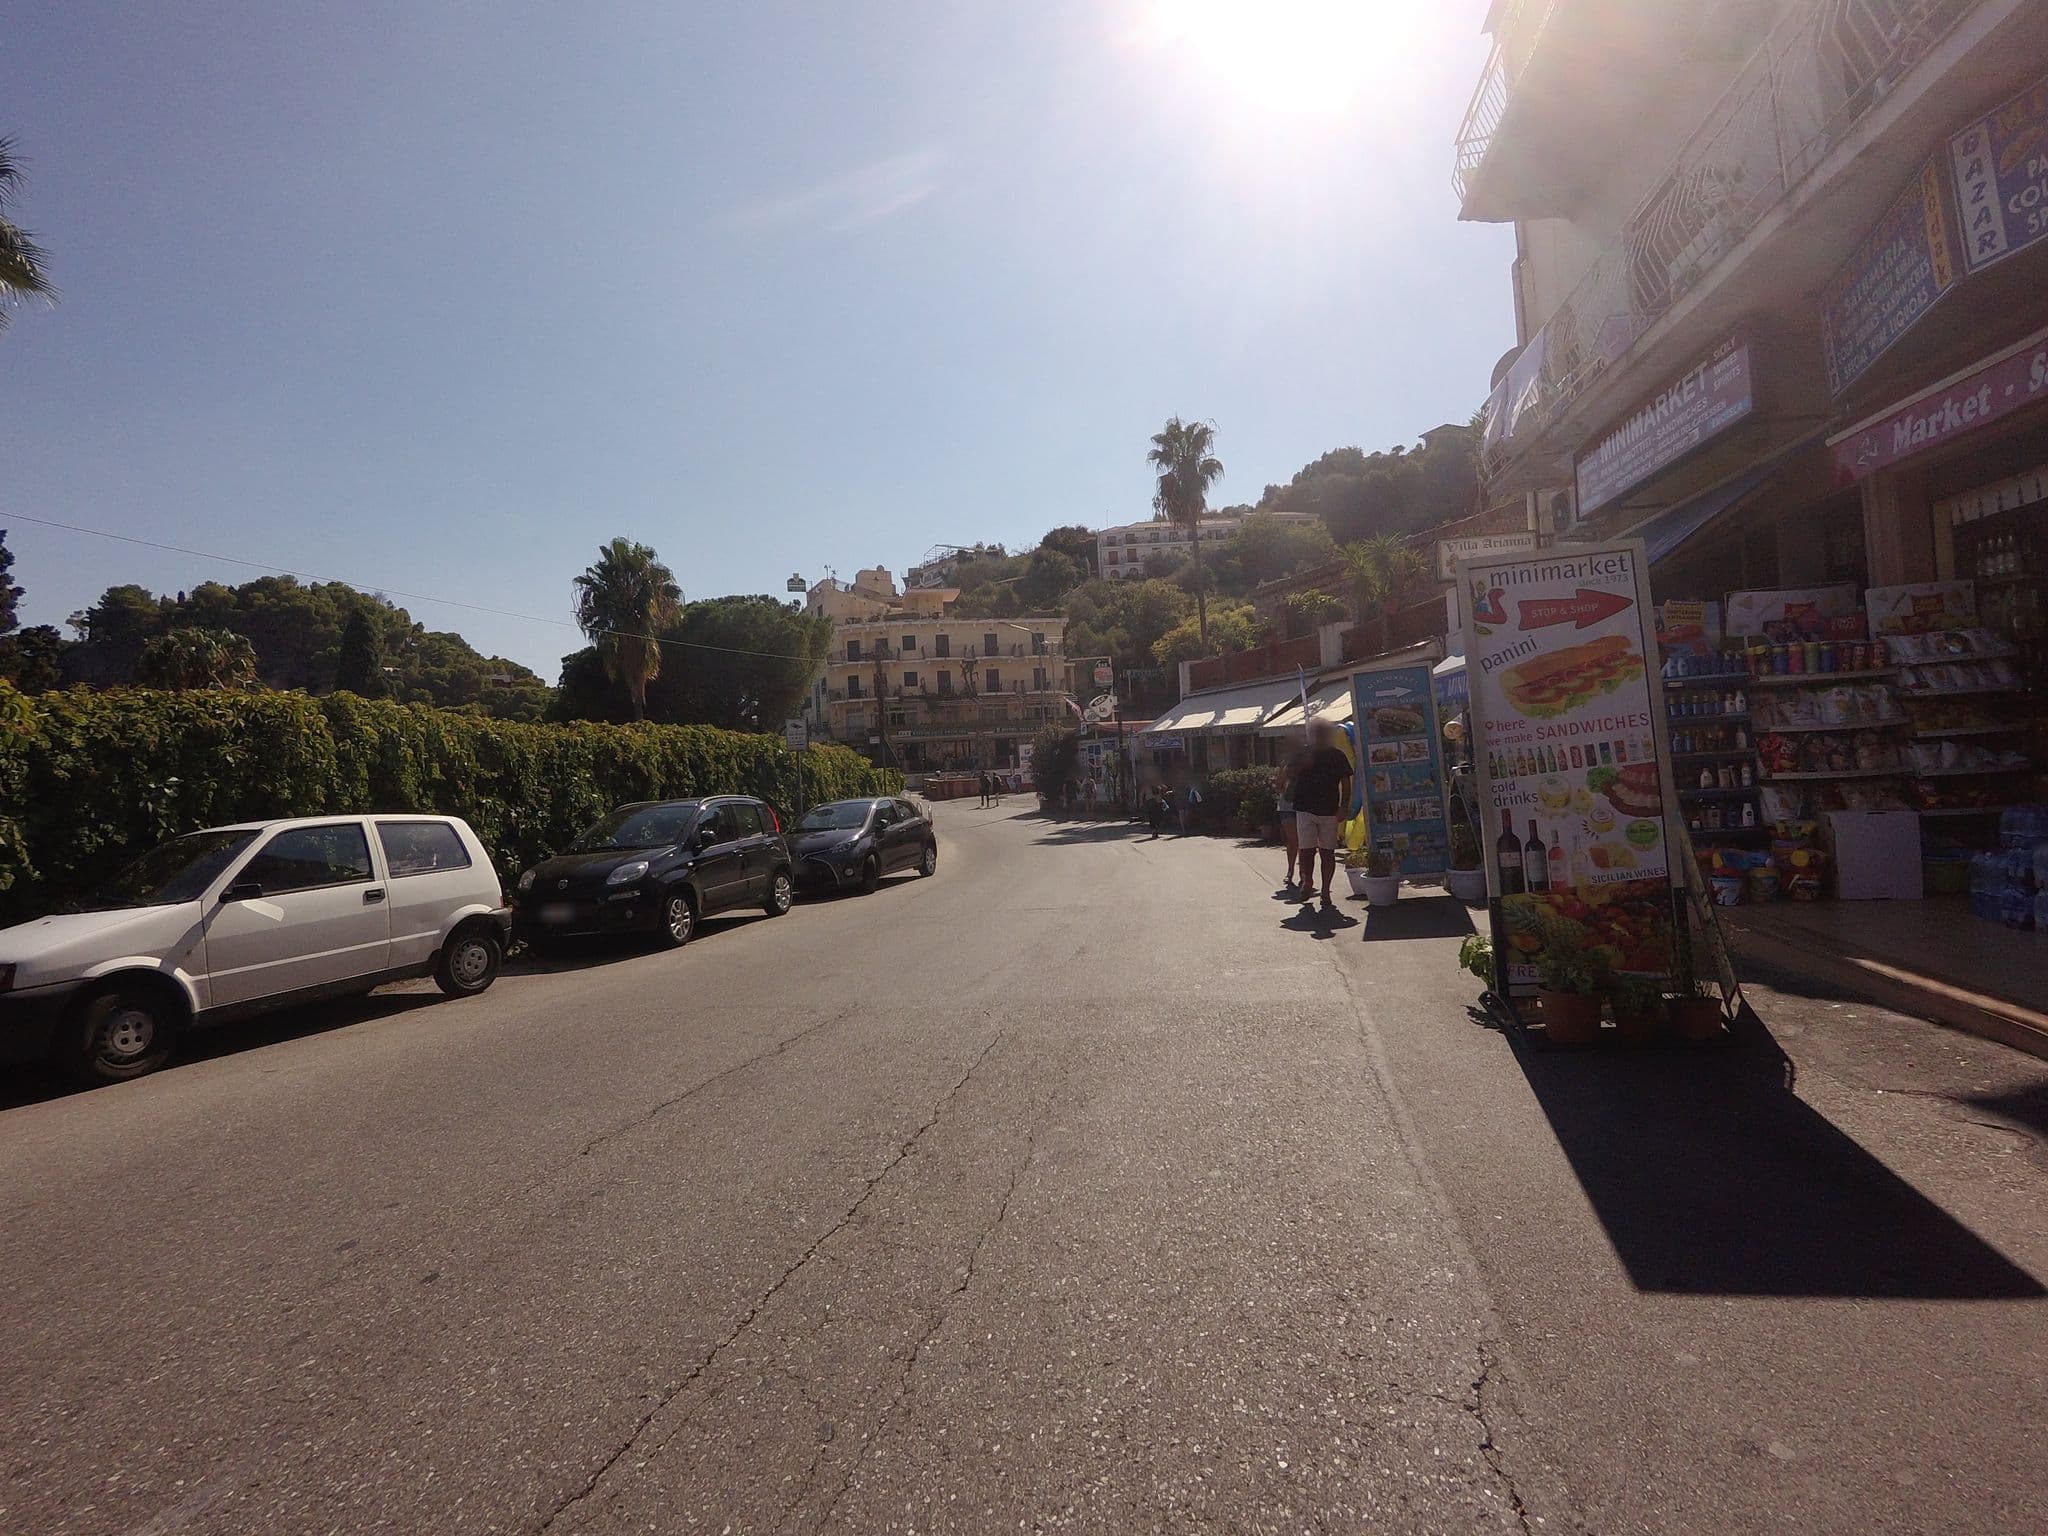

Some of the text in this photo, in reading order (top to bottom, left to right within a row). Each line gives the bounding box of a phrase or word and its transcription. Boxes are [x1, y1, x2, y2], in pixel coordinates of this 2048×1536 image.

[2028, 152, 2048, 179] PA
[1962, 132, 1997, 254] BAZAR
[2008, 178, 2048, 214] COL
[1600, 360, 1708, 464] MINIMARKET
[1893, 383, 1993, 454] Market
[1483, 537, 1532, 549] Arianna
[1490, 556, 1628, 587] minimarket
[1531, 607, 1557, 618] STOP
[1570, 603, 1599, 614] SHOP
[1480, 635, 1538, 674] panini
[1487, 713, 1650, 747] we make SANDWICHES
[1496, 719, 1526, 732] here
[1490, 780, 1517, 795] cold
[1493, 791, 1539, 808] drinks
[1591, 866, 1667, 885] SICILIAN WINES
